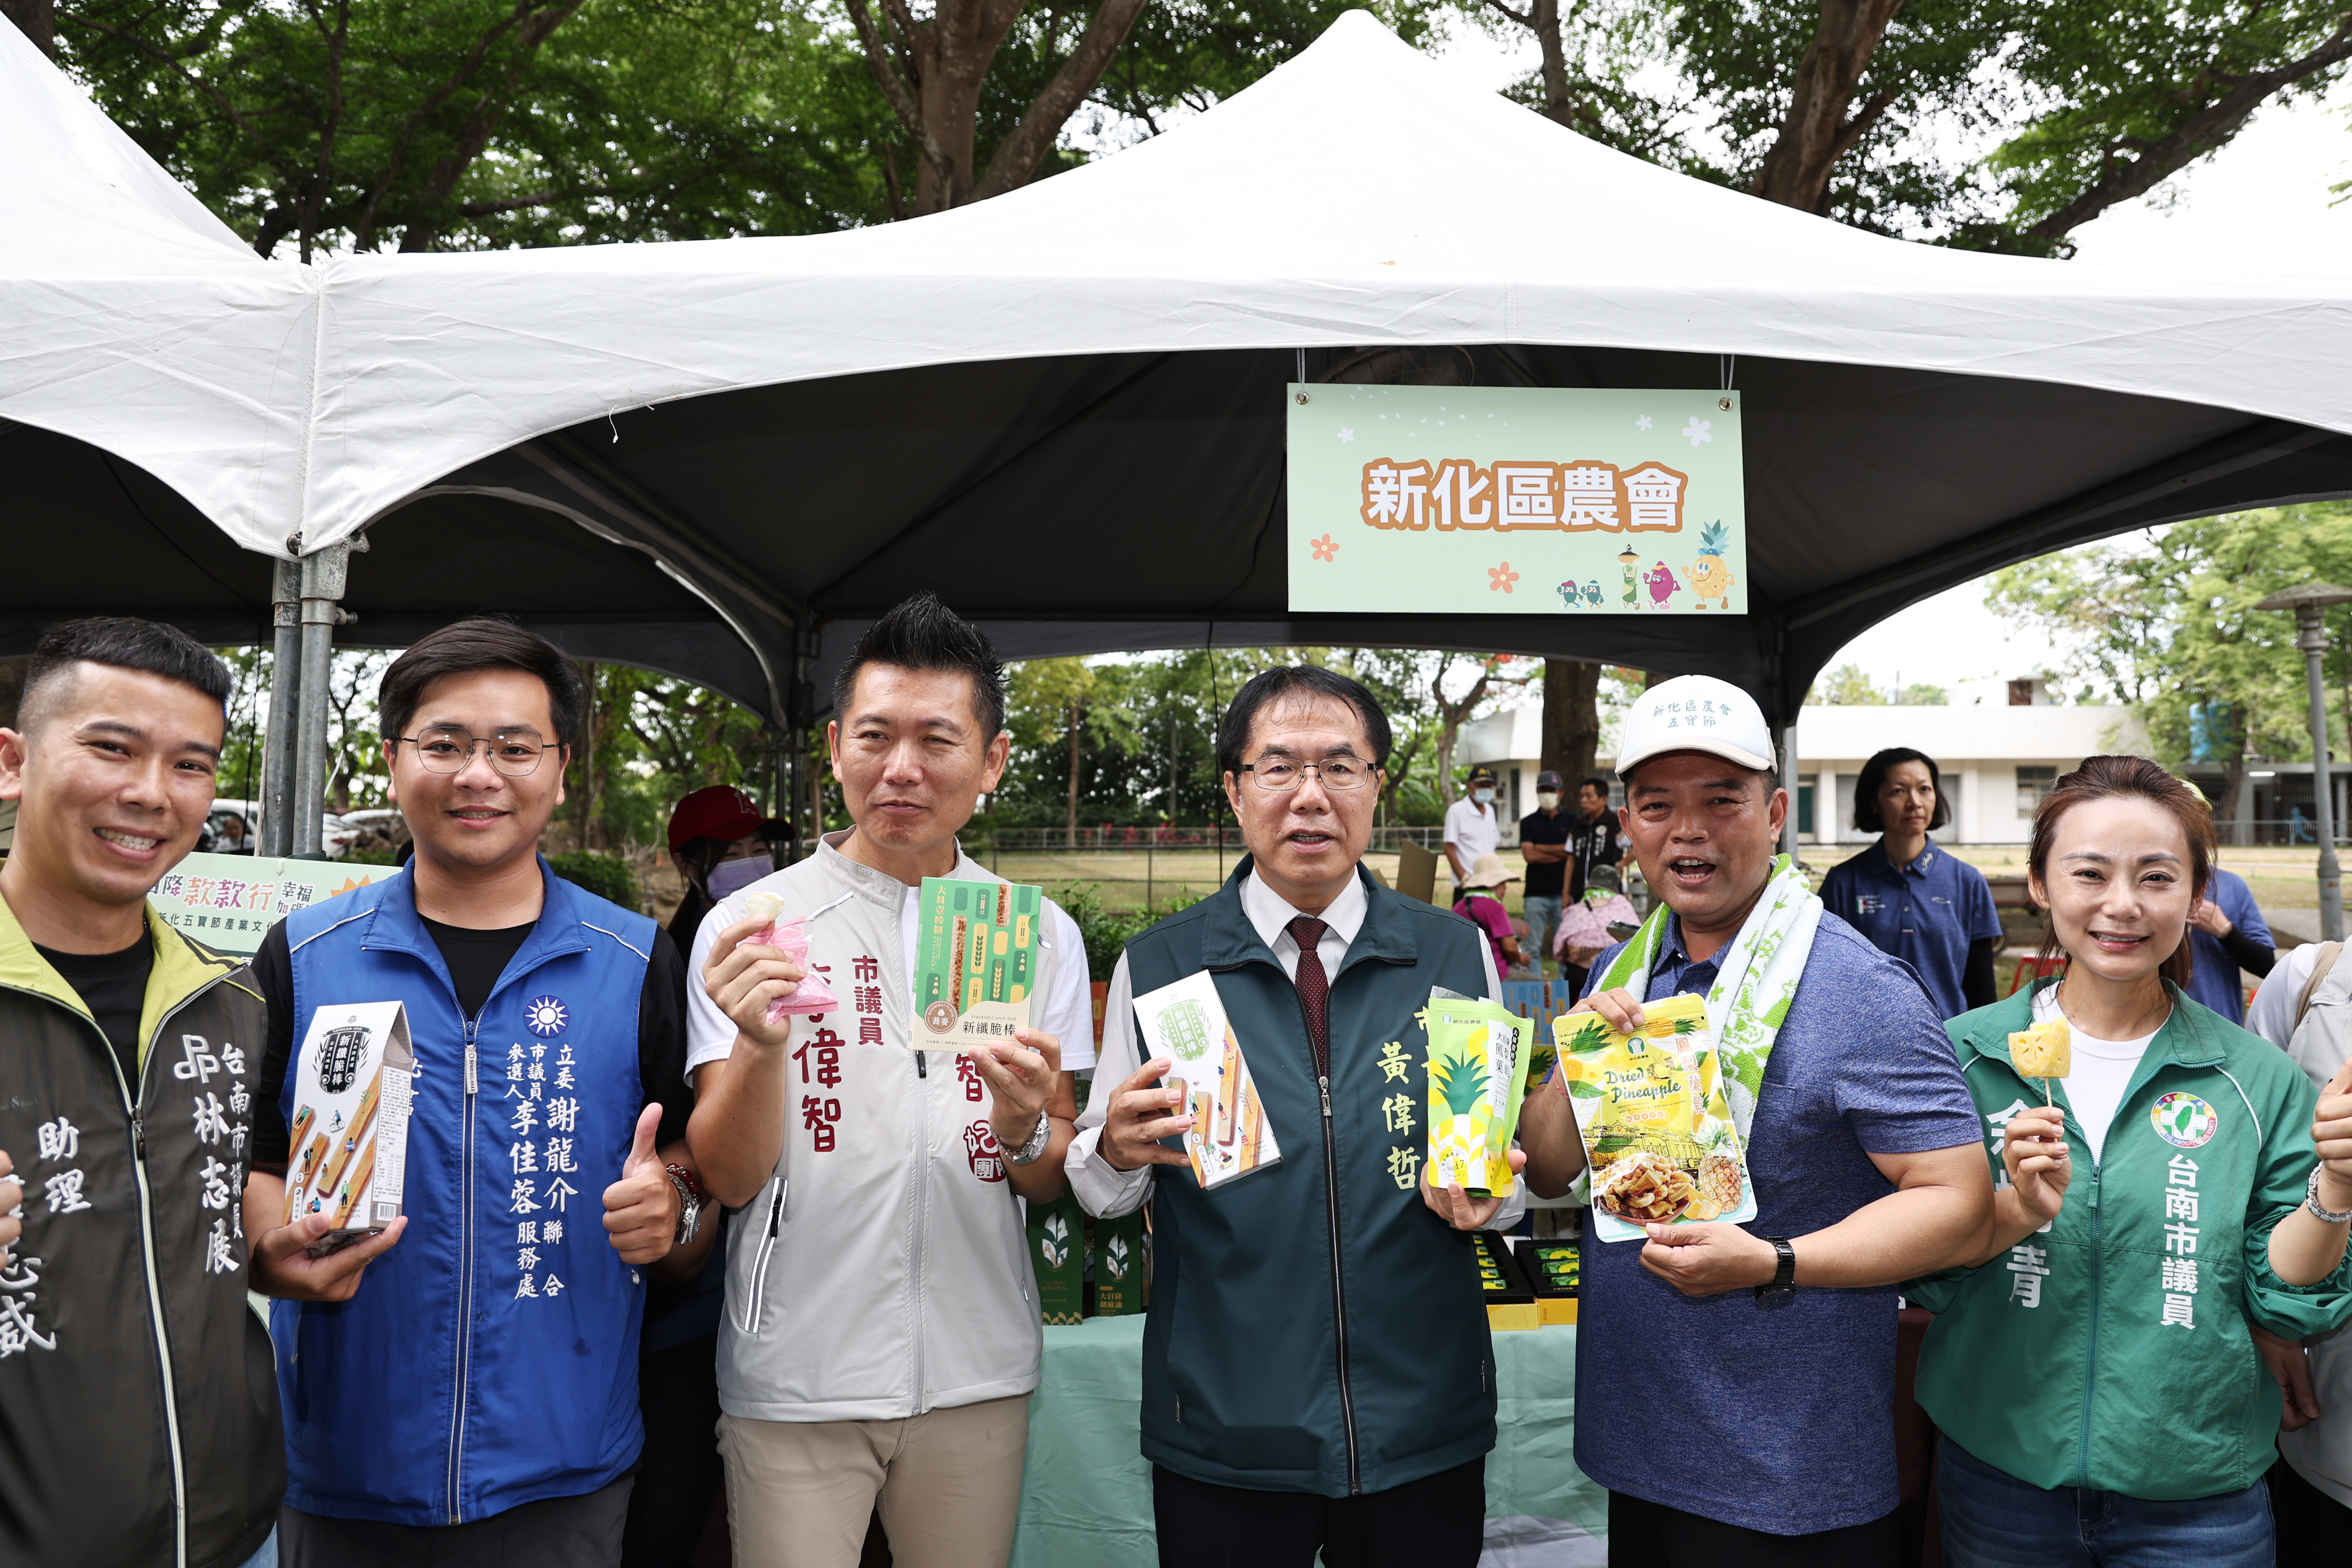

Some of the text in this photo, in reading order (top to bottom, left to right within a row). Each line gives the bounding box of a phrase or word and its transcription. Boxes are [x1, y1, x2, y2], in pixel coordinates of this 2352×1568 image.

[1366, 464, 1682, 527] 新化區農會
[1652, 700, 1732, 717] 新化區農會
[1667, 715, 1716, 728] 五寶節
[282, 881, 313, 902] 幸福
[852, 955, 884, 1046] 市議員
[932, 1017, 949, 1027] 蕎麥
[963, 1021, 1016, 1036] 新纖脆棒
[1174, 1009, 1198, 1053] 新纖脆棒
[331, 1035, 352, 1085] 新纖脆棒
[504, 1043, 526, 1100] 參選人
[528, 1043, 548, 1102] 市議員
[1603, 1067, 1644, 1085] Dried
[1675, 1036, 1706, 1115] 鳳梨菓乾
[1376, 1041, 1421, 1190] 黃偉哲
[1611, 1079, 1682, 1104] Pineapple
[220, 1042, 251, 1239] 台南市議員
[2152, 1113, 2216, 1146] DEMOCRATIC PROGRESSIVE PARTY
[39, 1116, 92, 1213] 助理
[2160, 1154, 2200, 1330] 台南市議員
